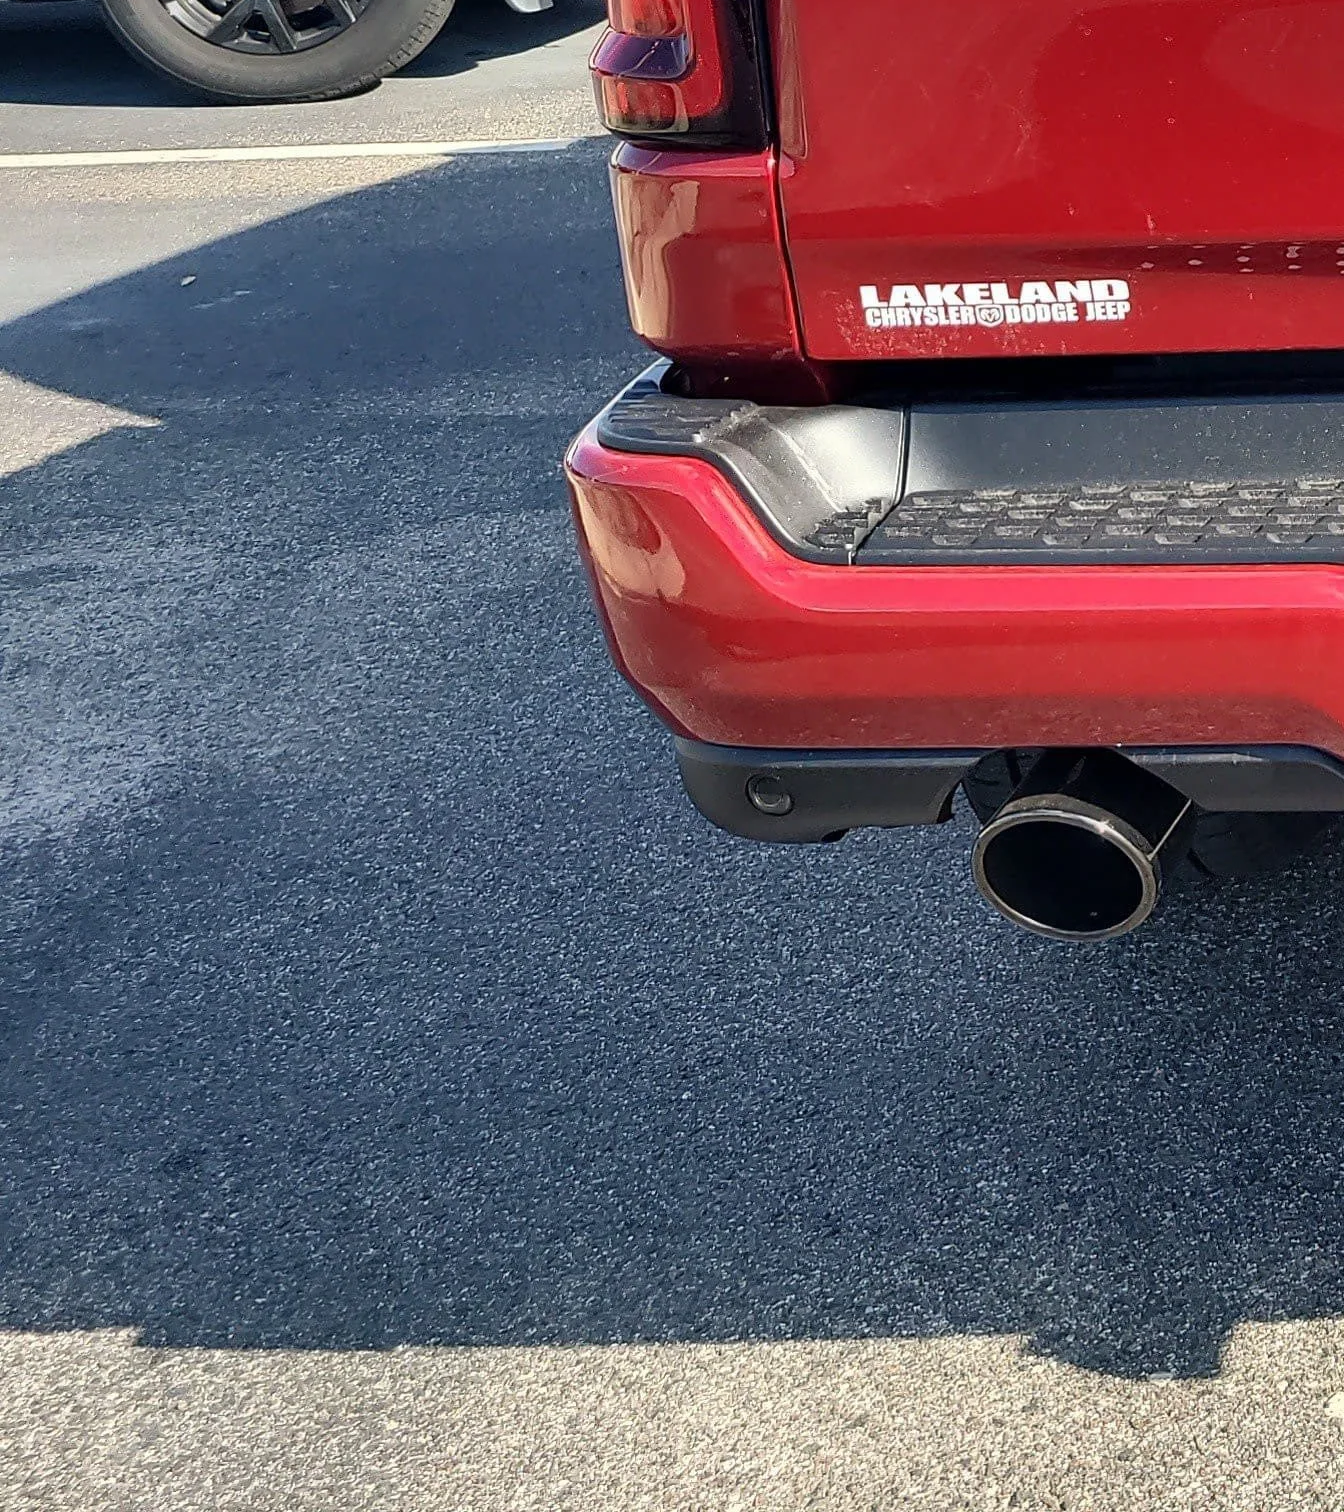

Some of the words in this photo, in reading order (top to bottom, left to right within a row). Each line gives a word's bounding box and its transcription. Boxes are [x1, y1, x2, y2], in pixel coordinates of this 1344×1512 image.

[859, 279, 1130, 307] LAKELAND
[865, 305, 975, 327] CHRYSLER
[1003, 303, 1078, 323] DODGE
[1086, 301, 1131, 321] JEEP
